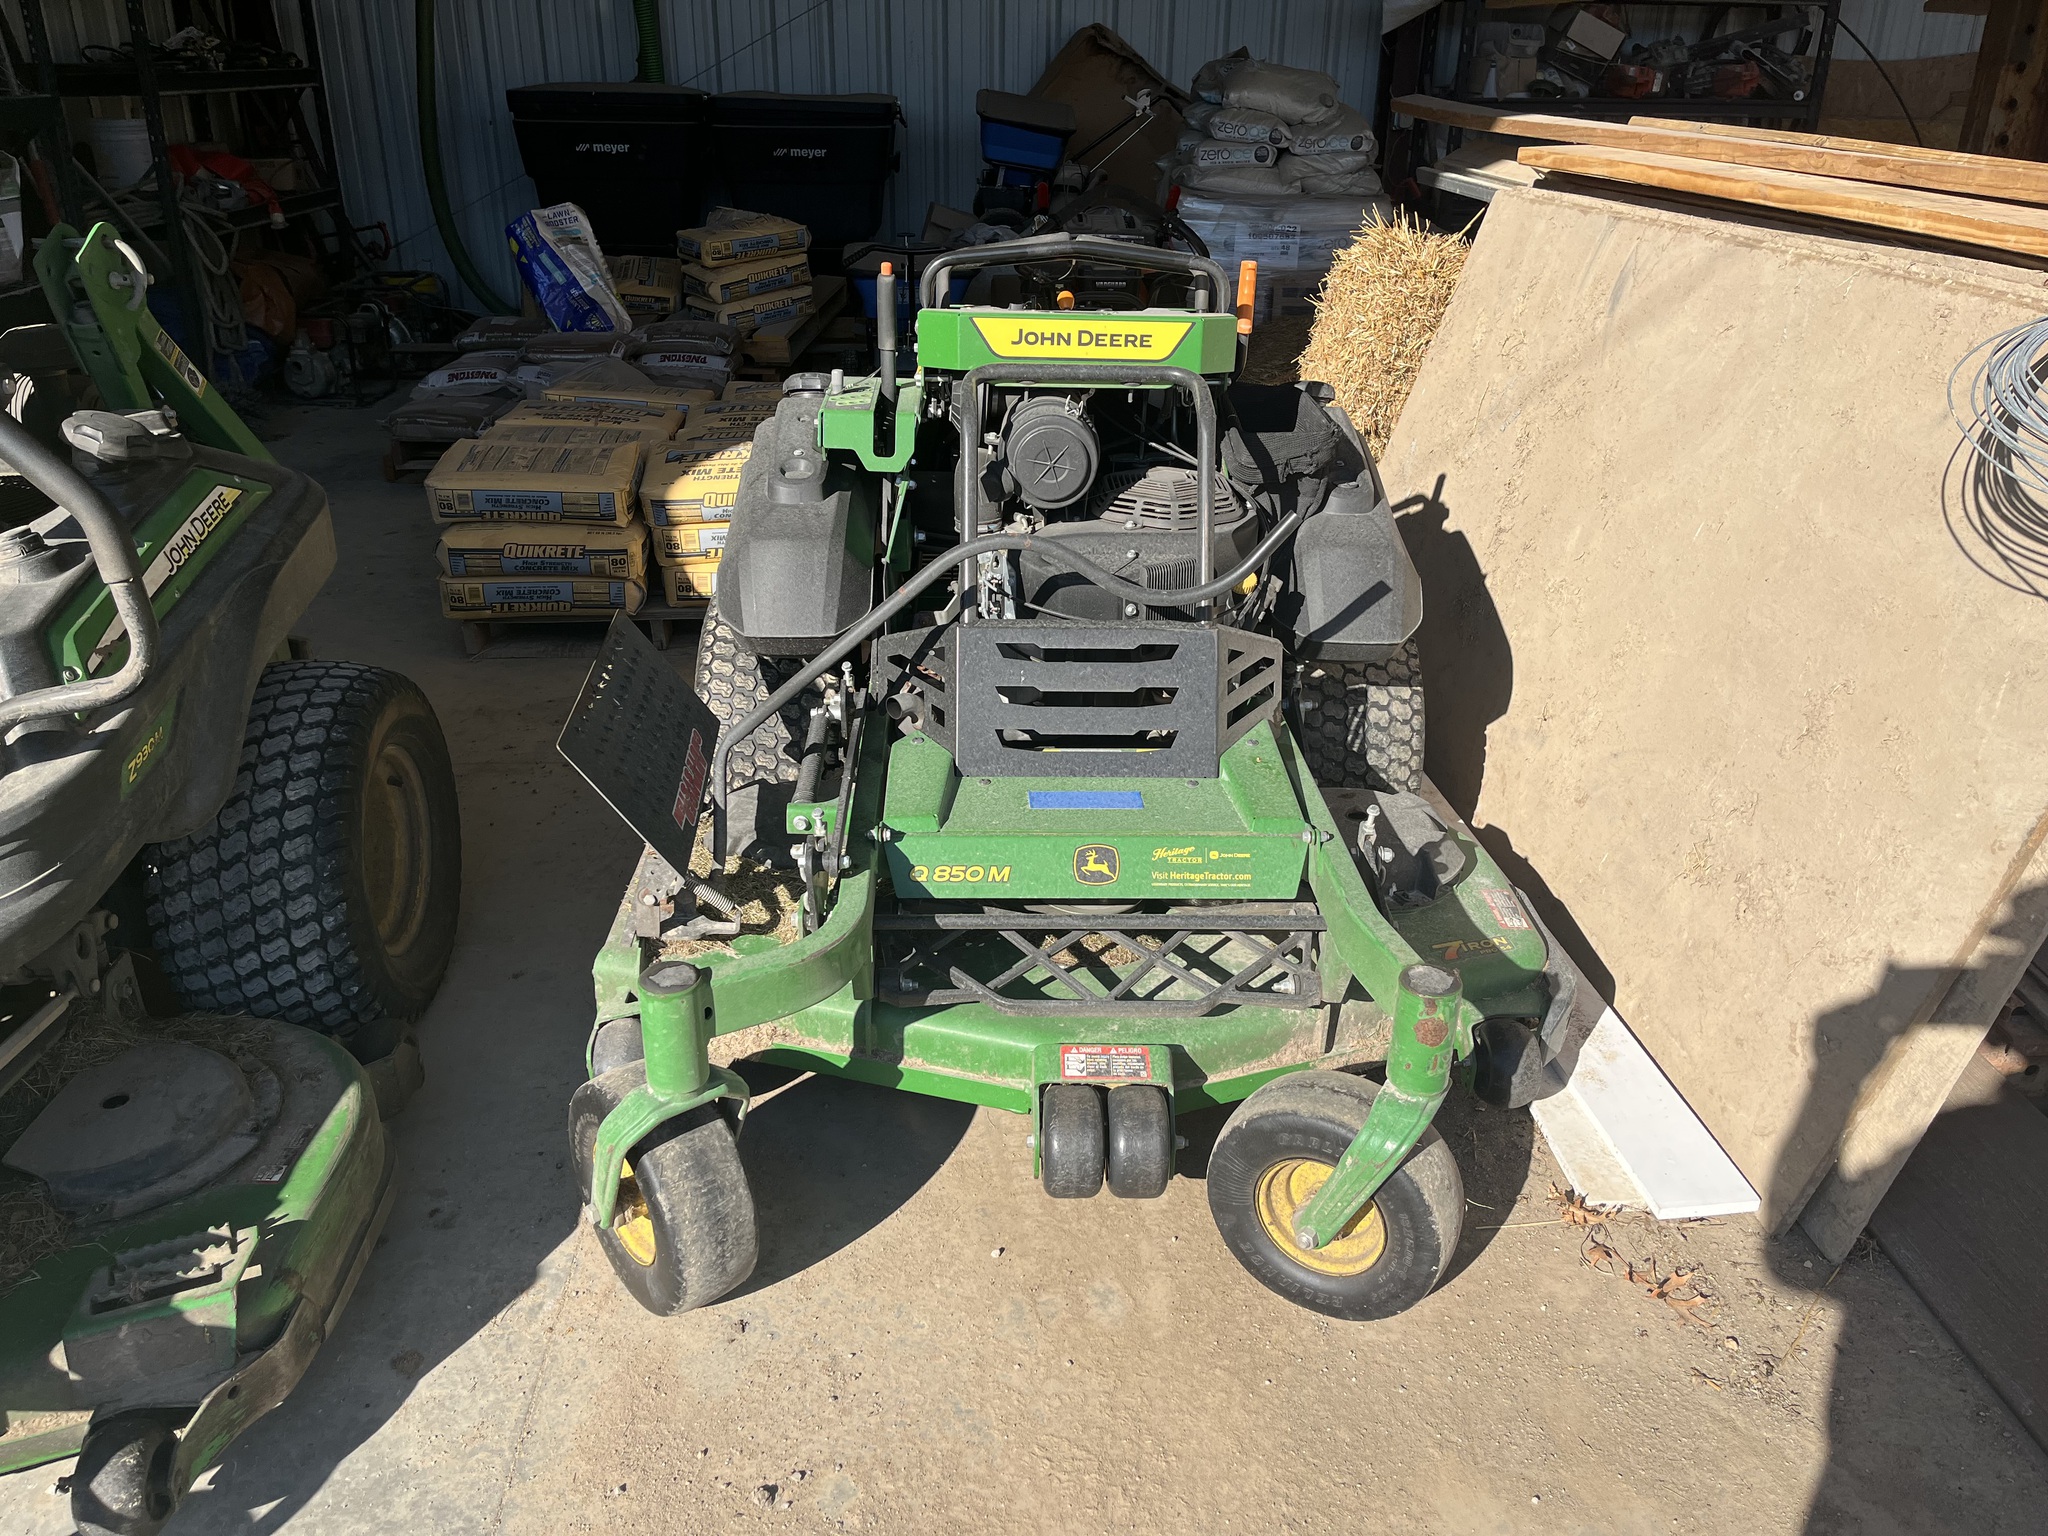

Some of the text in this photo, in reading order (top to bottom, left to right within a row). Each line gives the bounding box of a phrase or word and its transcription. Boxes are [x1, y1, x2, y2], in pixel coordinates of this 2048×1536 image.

[593, 141, 630, 154] meyer
[790, 146, 828, 159] meyer
[547, 209, 570, 220] LAWN
[1318, 238, 1348, 250] zero
[734, 247, 778, 260] QUIKRETE
[748, 265, 788, 282] QUIKRETE
[753, 298, 793, 314] QUIKRETE
[1011, 328, 1152, 348] JOHN DEERE
[660, 354, 708, 364] PAVESTONE
[448, 370, 498, 383] PAVESTONE
[679, 449, 750, 464] KRETE
[439, 502, 453, 511] 80
[481, 511, 562, 521] QUIKRETE
[163, 492, 230, 573] JOHN DEERE
[504, 543, 585, 558] QUIKRETE
[611, 558, 626, 566] 80
[491, 602, 572, 613] QUIKRETE
[1152, 846, 1196, 861] Heritage
[910, 865, 1012, 882] Q 850 M
[1152, 871, 1252, 882] Visit HeritageTractor.com
